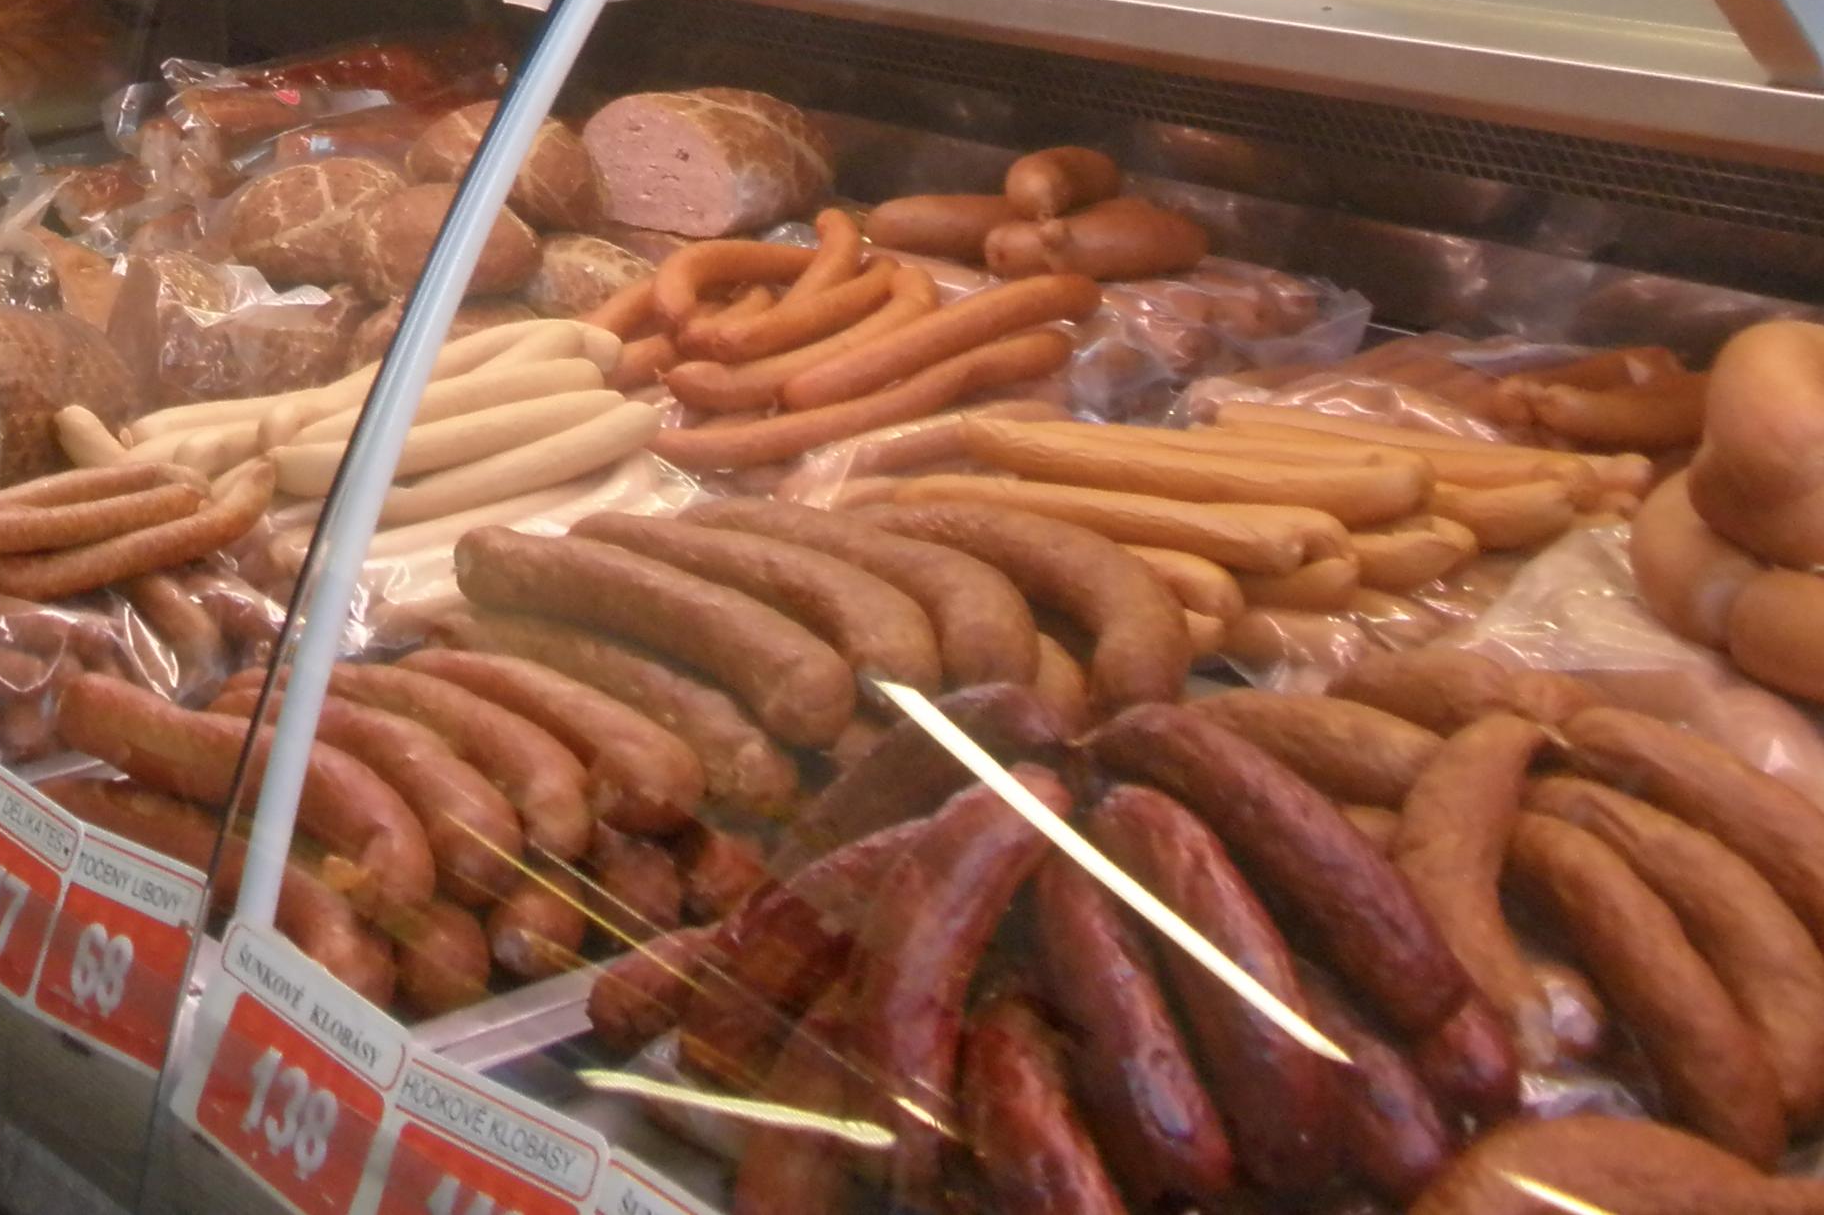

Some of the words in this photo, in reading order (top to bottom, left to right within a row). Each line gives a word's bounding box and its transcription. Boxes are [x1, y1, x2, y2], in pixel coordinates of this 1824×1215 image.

[70, 923, 134, 1018] 68
[309, 1001, 381, 1069] KLOBÁSY
[241, 1047, 338, 1181] 138
